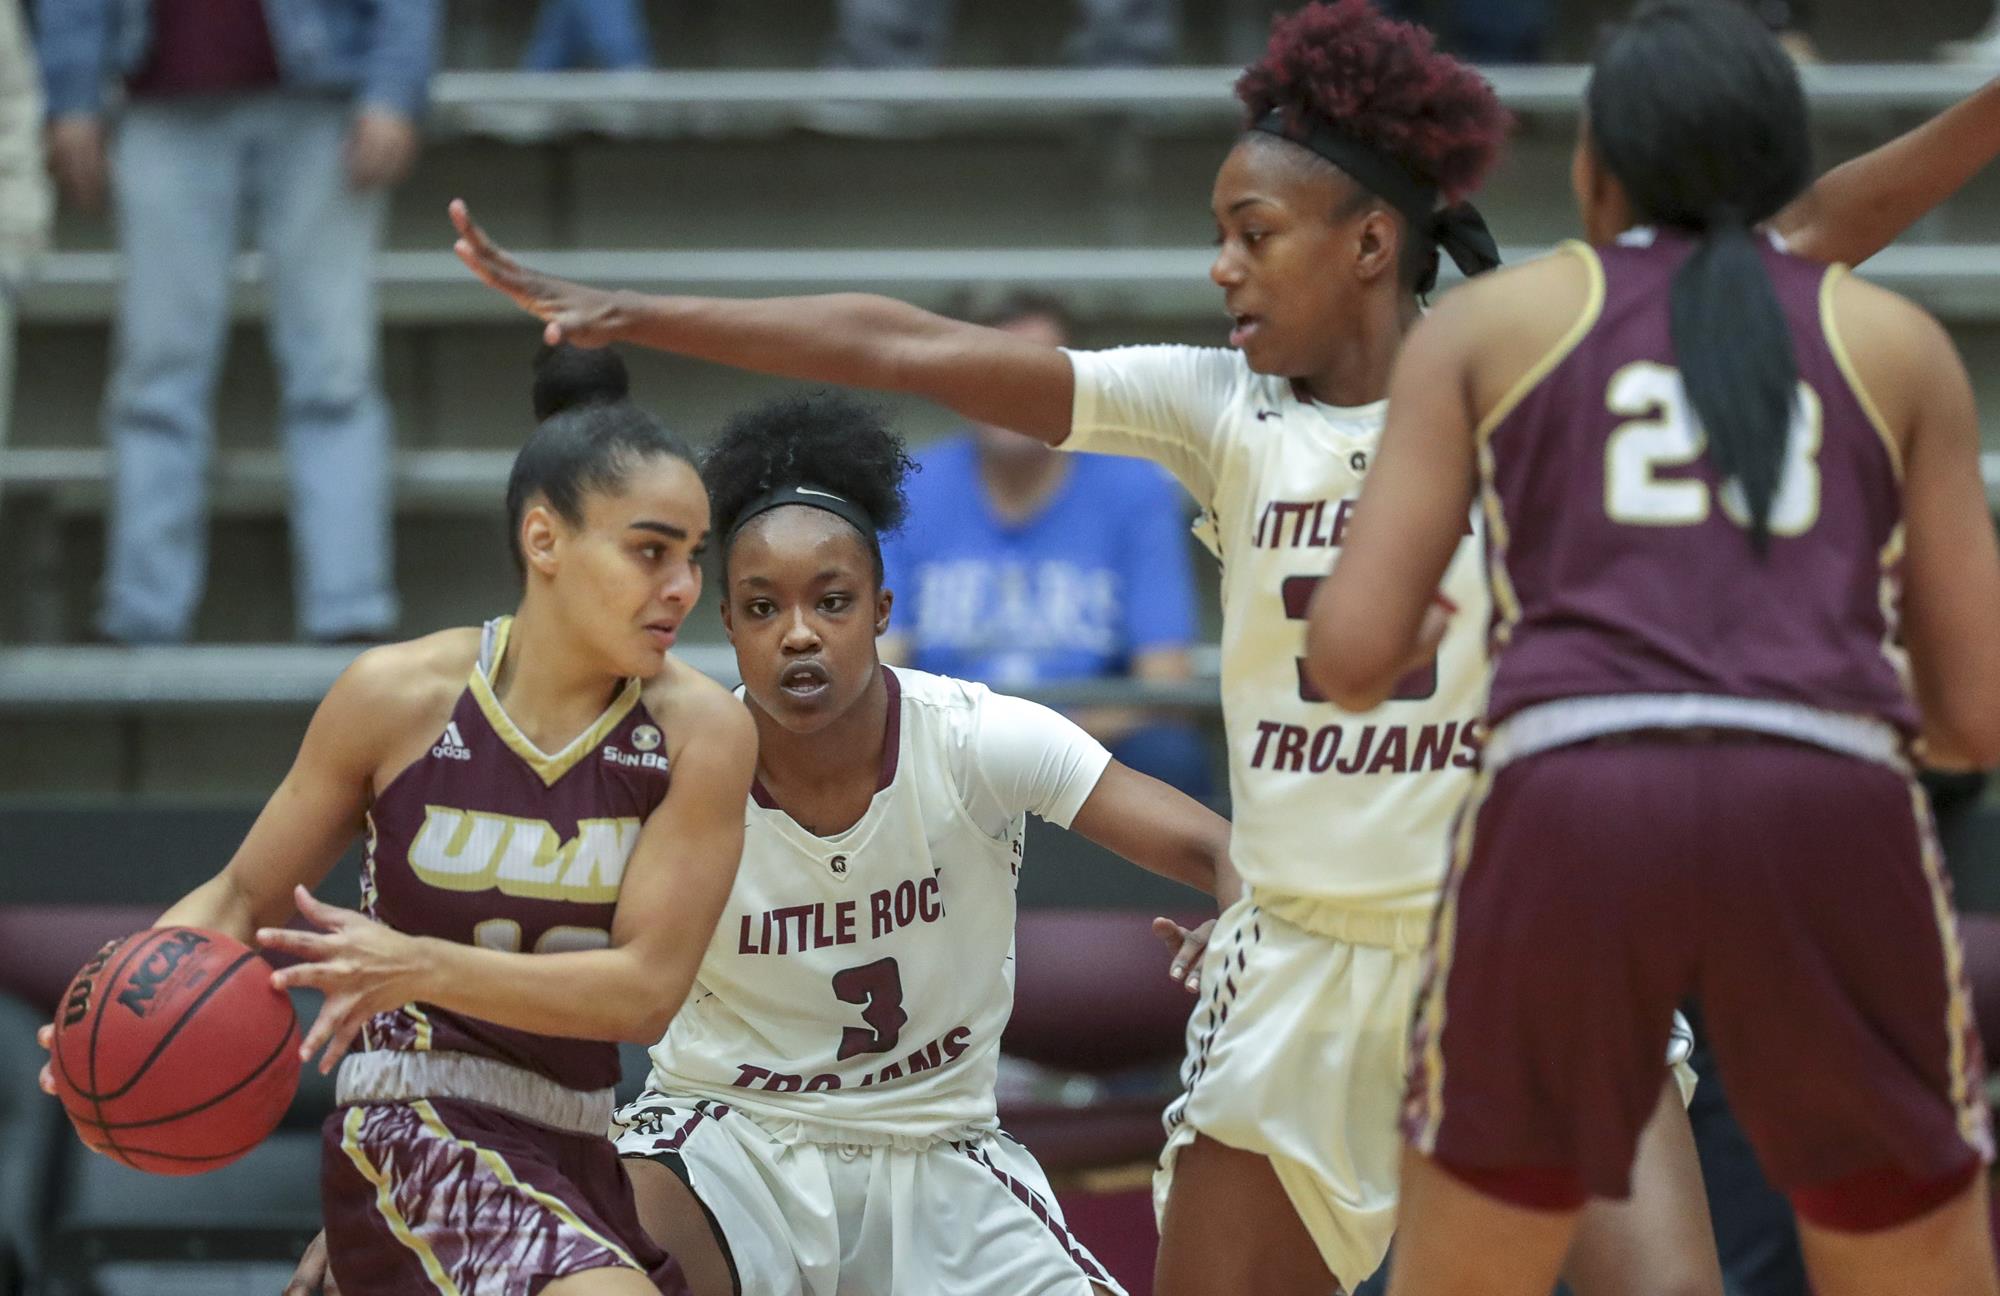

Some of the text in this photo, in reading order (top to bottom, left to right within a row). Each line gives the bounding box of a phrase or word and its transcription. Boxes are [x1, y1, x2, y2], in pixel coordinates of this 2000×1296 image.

[1253, 499, 1364, 549] ITTLE
[1251, 720, 1481, 774] TROJANS
[738, 867, 946, 955] LITTLE ROC
[117, 930, 210, 1018] NCAA
[832, 956, 908, 1062] 3
